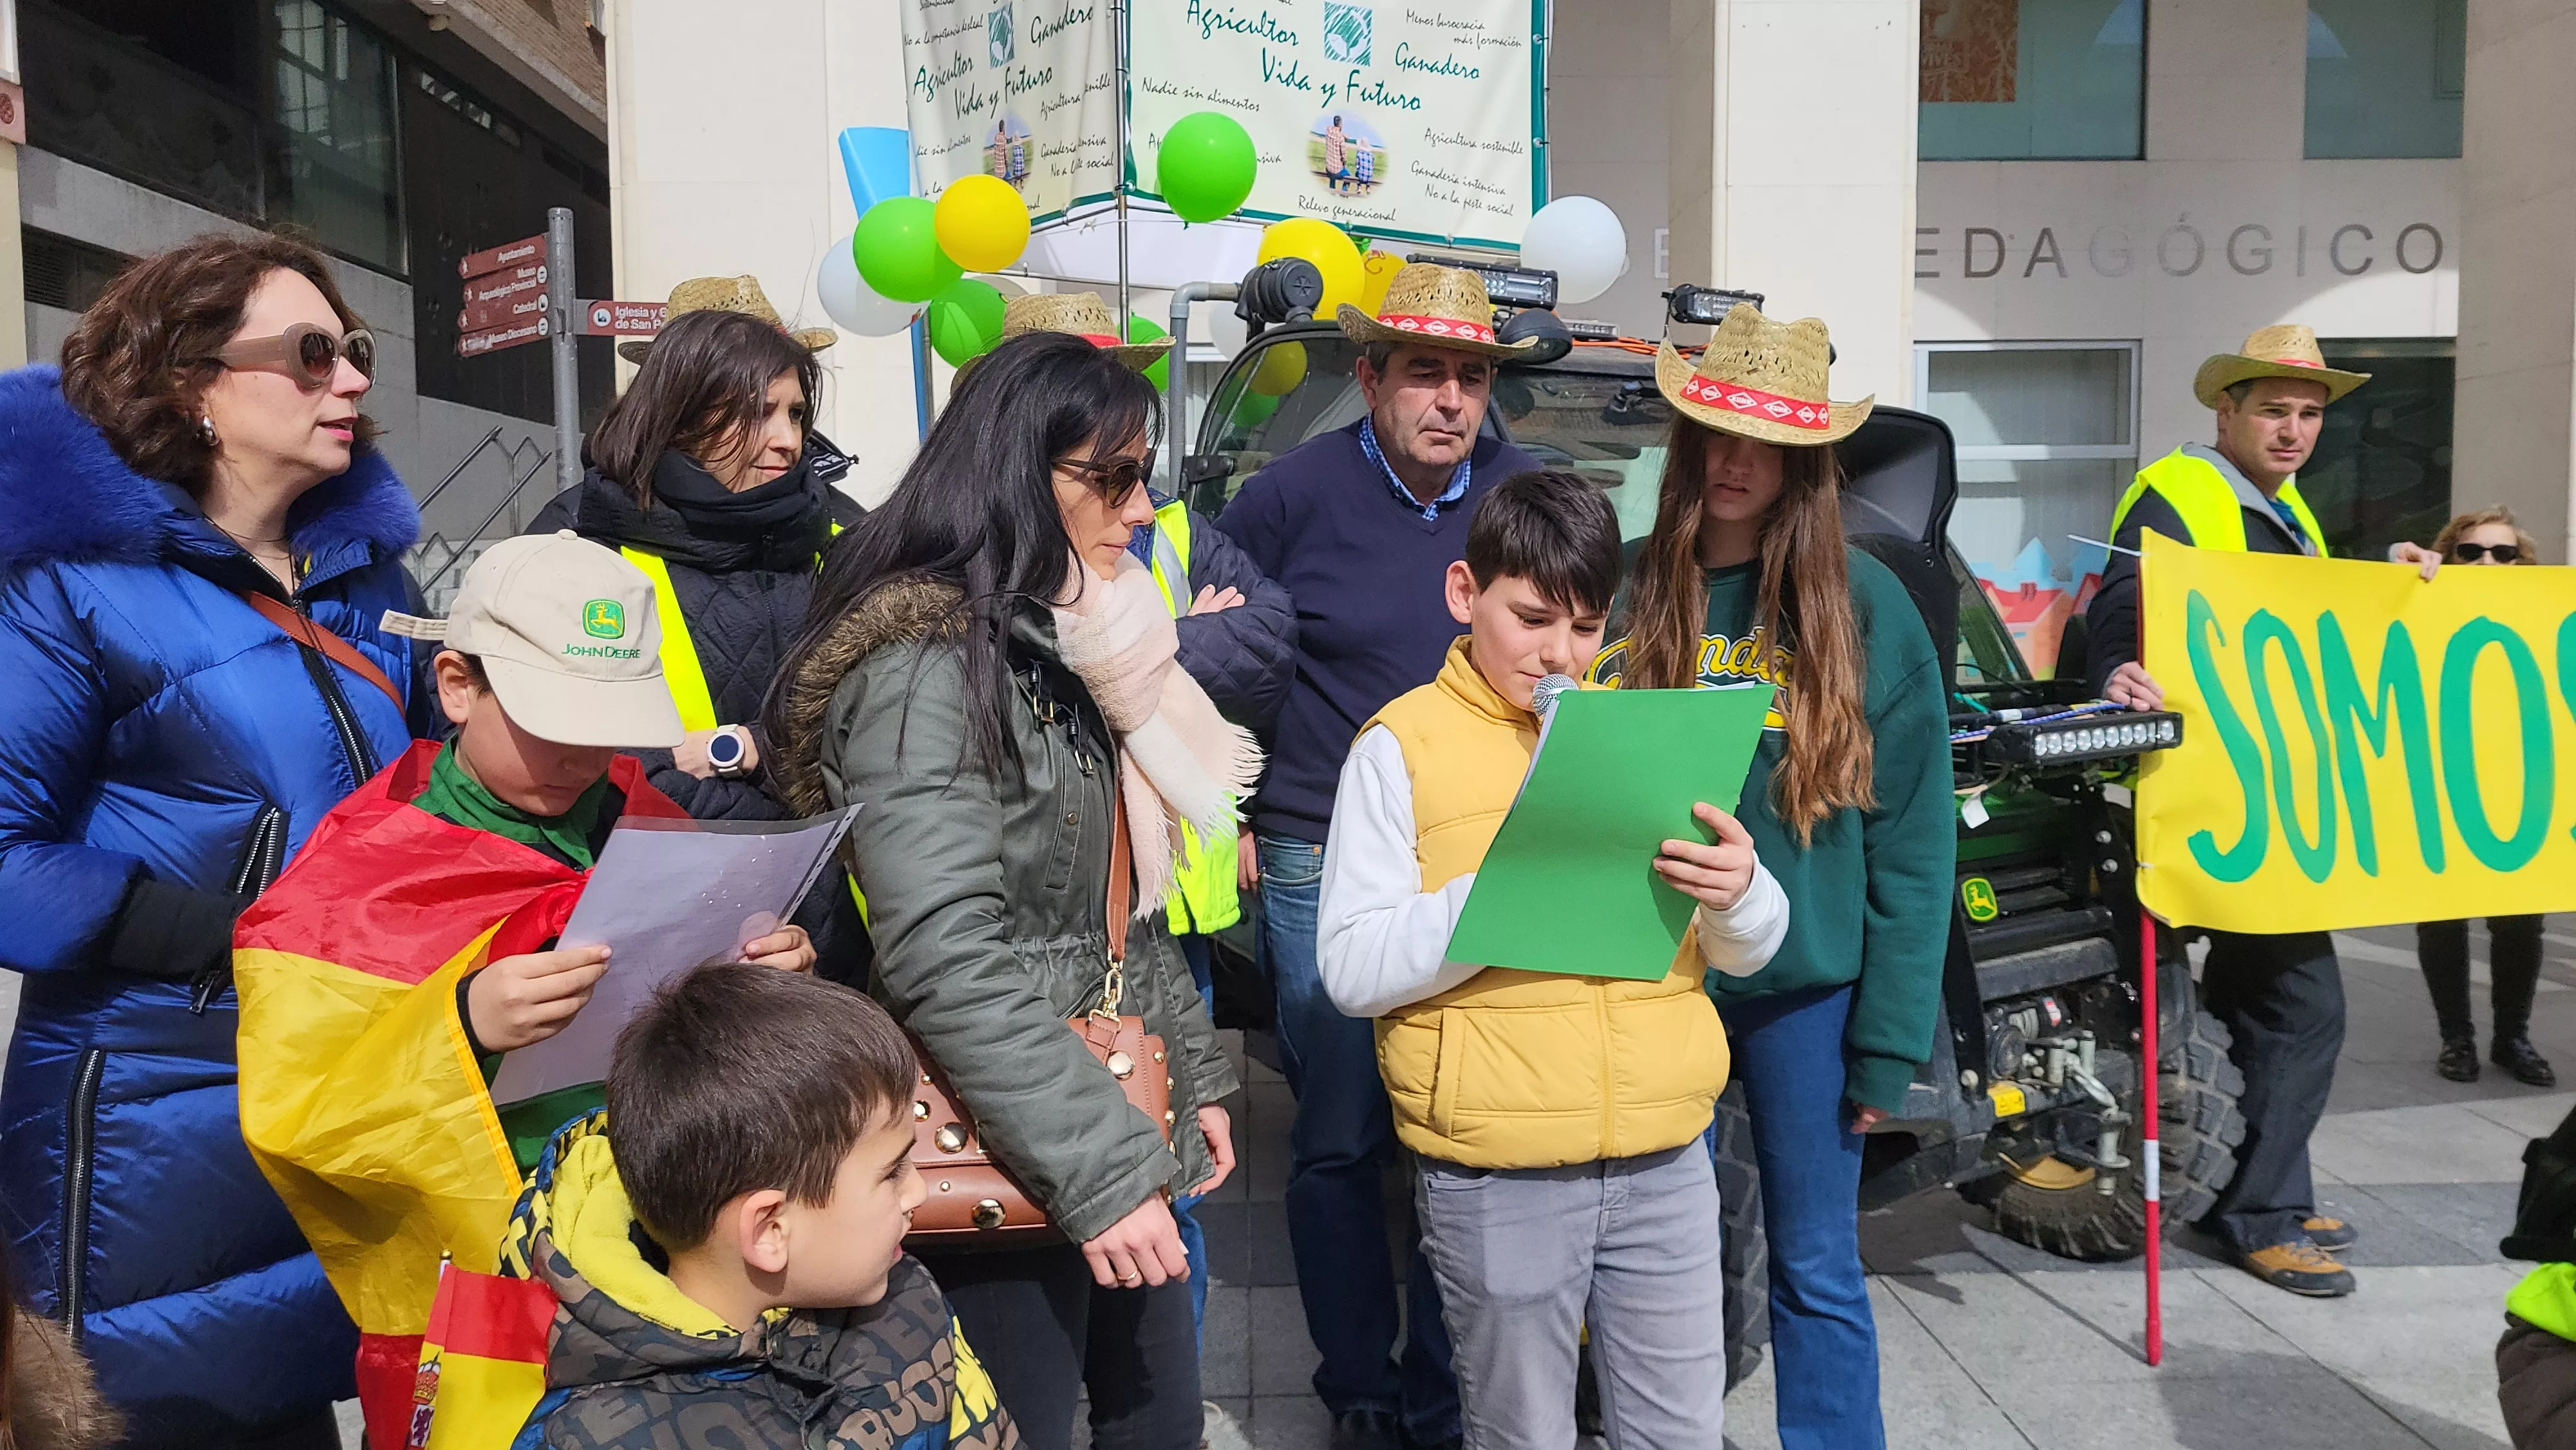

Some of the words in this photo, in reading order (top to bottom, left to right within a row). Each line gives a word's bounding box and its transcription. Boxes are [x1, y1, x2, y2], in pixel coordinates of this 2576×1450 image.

[1188, 0, 1298, 46] Agricultor
[1406, 8, 1434, 26] Menos
[1437, 13, 1486, 30] burocracia
[1395, 42, 1479, 79] Ganadero
[1142, 77, 1177, 95] Nadie
[1182, 86, 1204, 99] sin
[1208, 89, 1260, 112] alimentos
[1262, 48, 1311, 91] Vida
[1320, 83, 1336, 109] y
[1347, 69, 1421, 110] Futuro
[955, 82, 984, 120] Vida
[1424, 127, 1477, 147] Agricultura
[1481, 140, 1524, 155] sostenible
[1425, 184, 1438, 198] No
[1487, 204, 1513, 216] social
[1463, 176, 1506, 195] intensiva
[1298, 194, 1329, 212] Relevo
[1332, 205, 1396, 221] generacional
[1915, 212, 2444, 278] EDAGÓGICO
[614, 318, 629, 330] de
[630, 318, 651, 330] San
[615, 305, 649, 319] Iglesia
[650, 308, 657, 320] y
